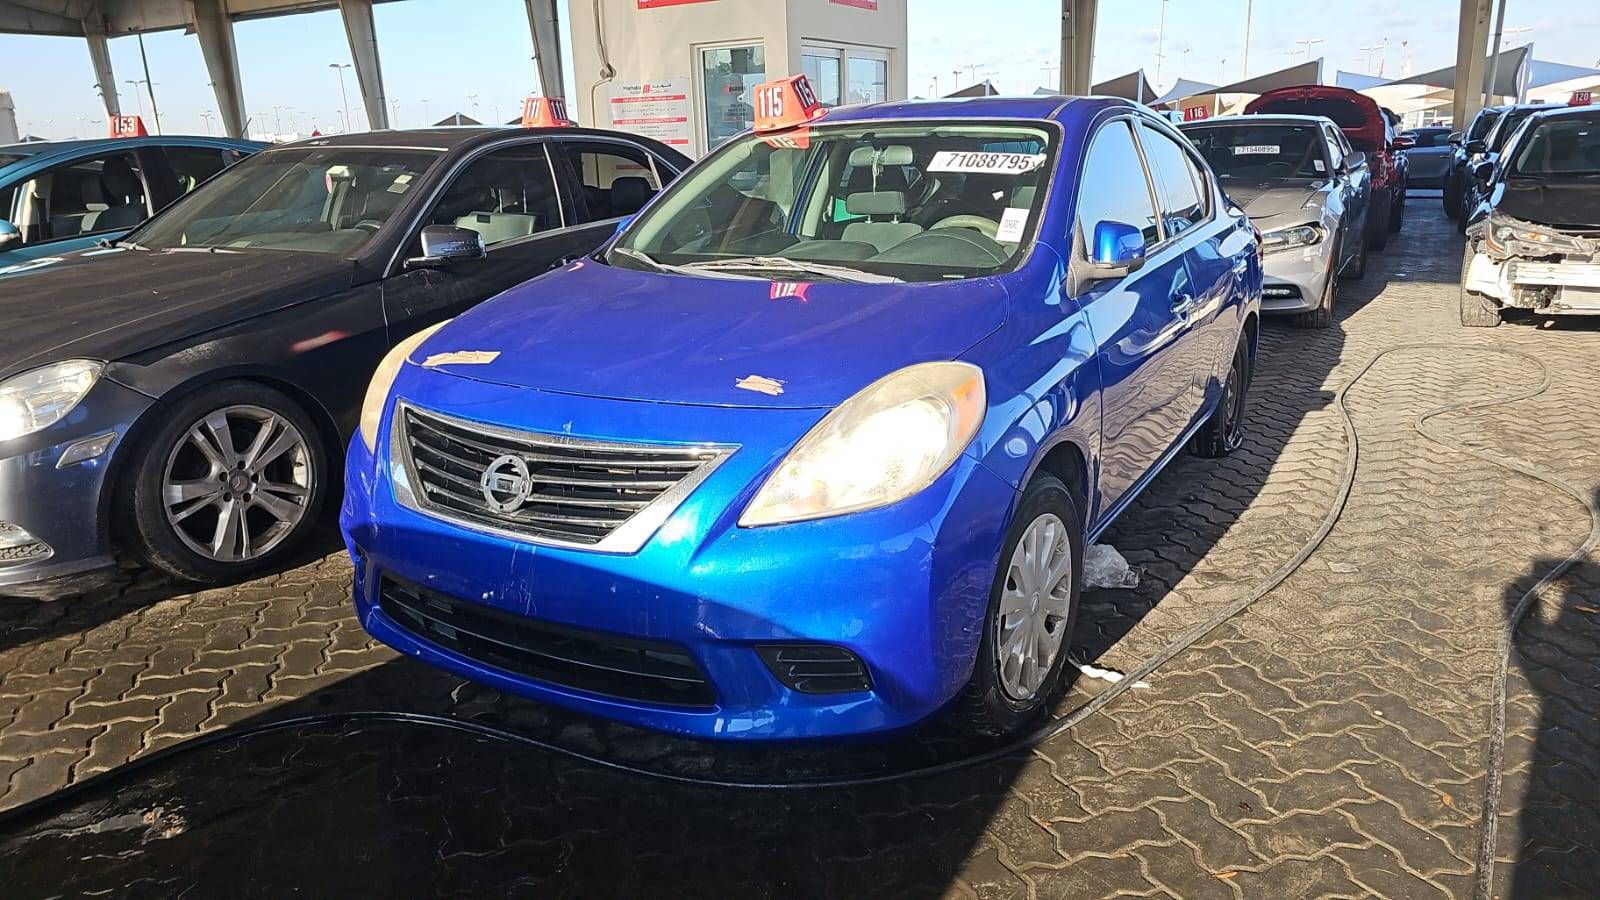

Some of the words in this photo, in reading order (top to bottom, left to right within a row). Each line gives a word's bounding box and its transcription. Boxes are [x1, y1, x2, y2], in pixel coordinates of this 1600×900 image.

[759, 87, 783, 117] 115
[1575, 91, 1589, 102] 120
[526, 100, 541, 119] 111
[1189, 107, 1204, 119] 116
[114, 117, 134, 133] 153
[945, 153, 1032, 170] 71088795
